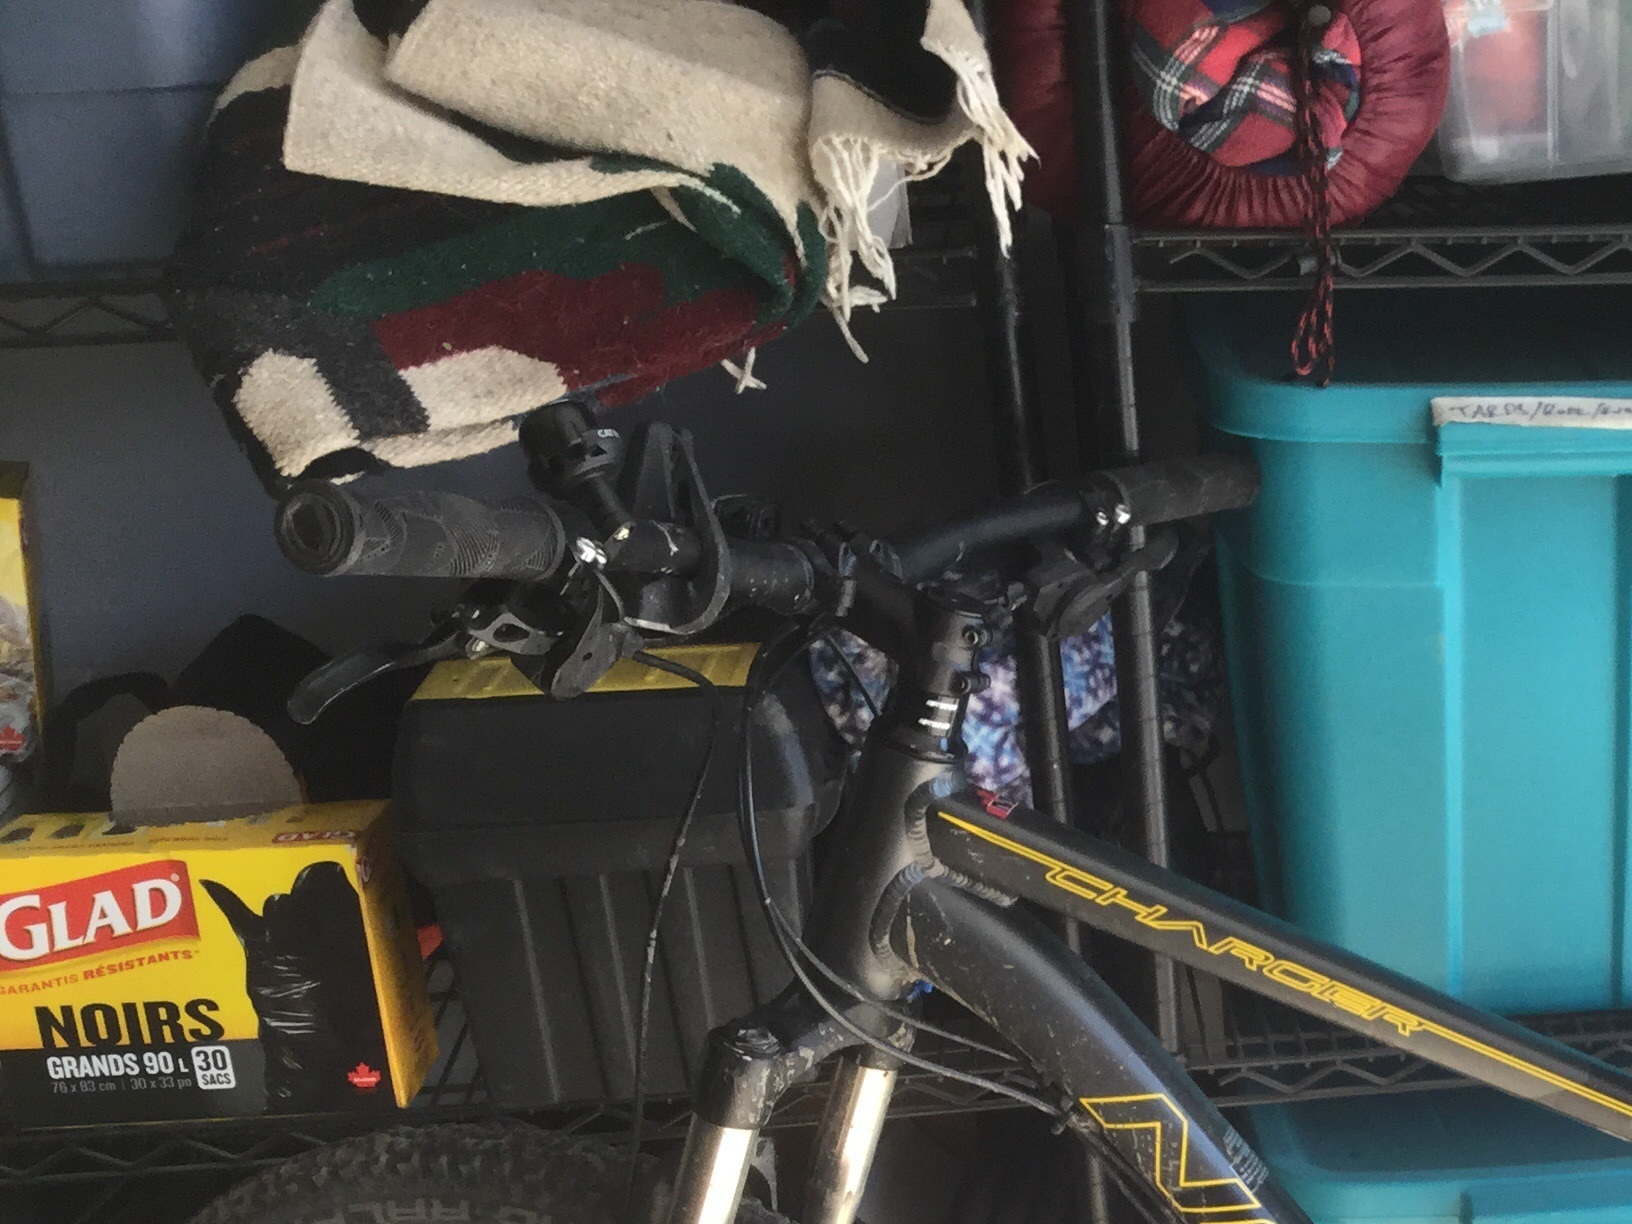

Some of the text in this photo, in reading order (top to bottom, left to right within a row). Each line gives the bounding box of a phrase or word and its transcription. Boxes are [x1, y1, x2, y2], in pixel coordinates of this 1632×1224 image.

[0, 878, 184, 961] GLAD
[82, 949, 194, 981] RÉSISTANTS
[1045, 865, 1425, 1037] CHARGER
[35, 998, 226, 1050] NOIRS
[47, 1051, 189, 1080] GRANDS 90 L
[197, 1049, 228, 1072] 30
[98, 1081, 116, 1091] cm
[201, 1072, 232, 1086] SACS
